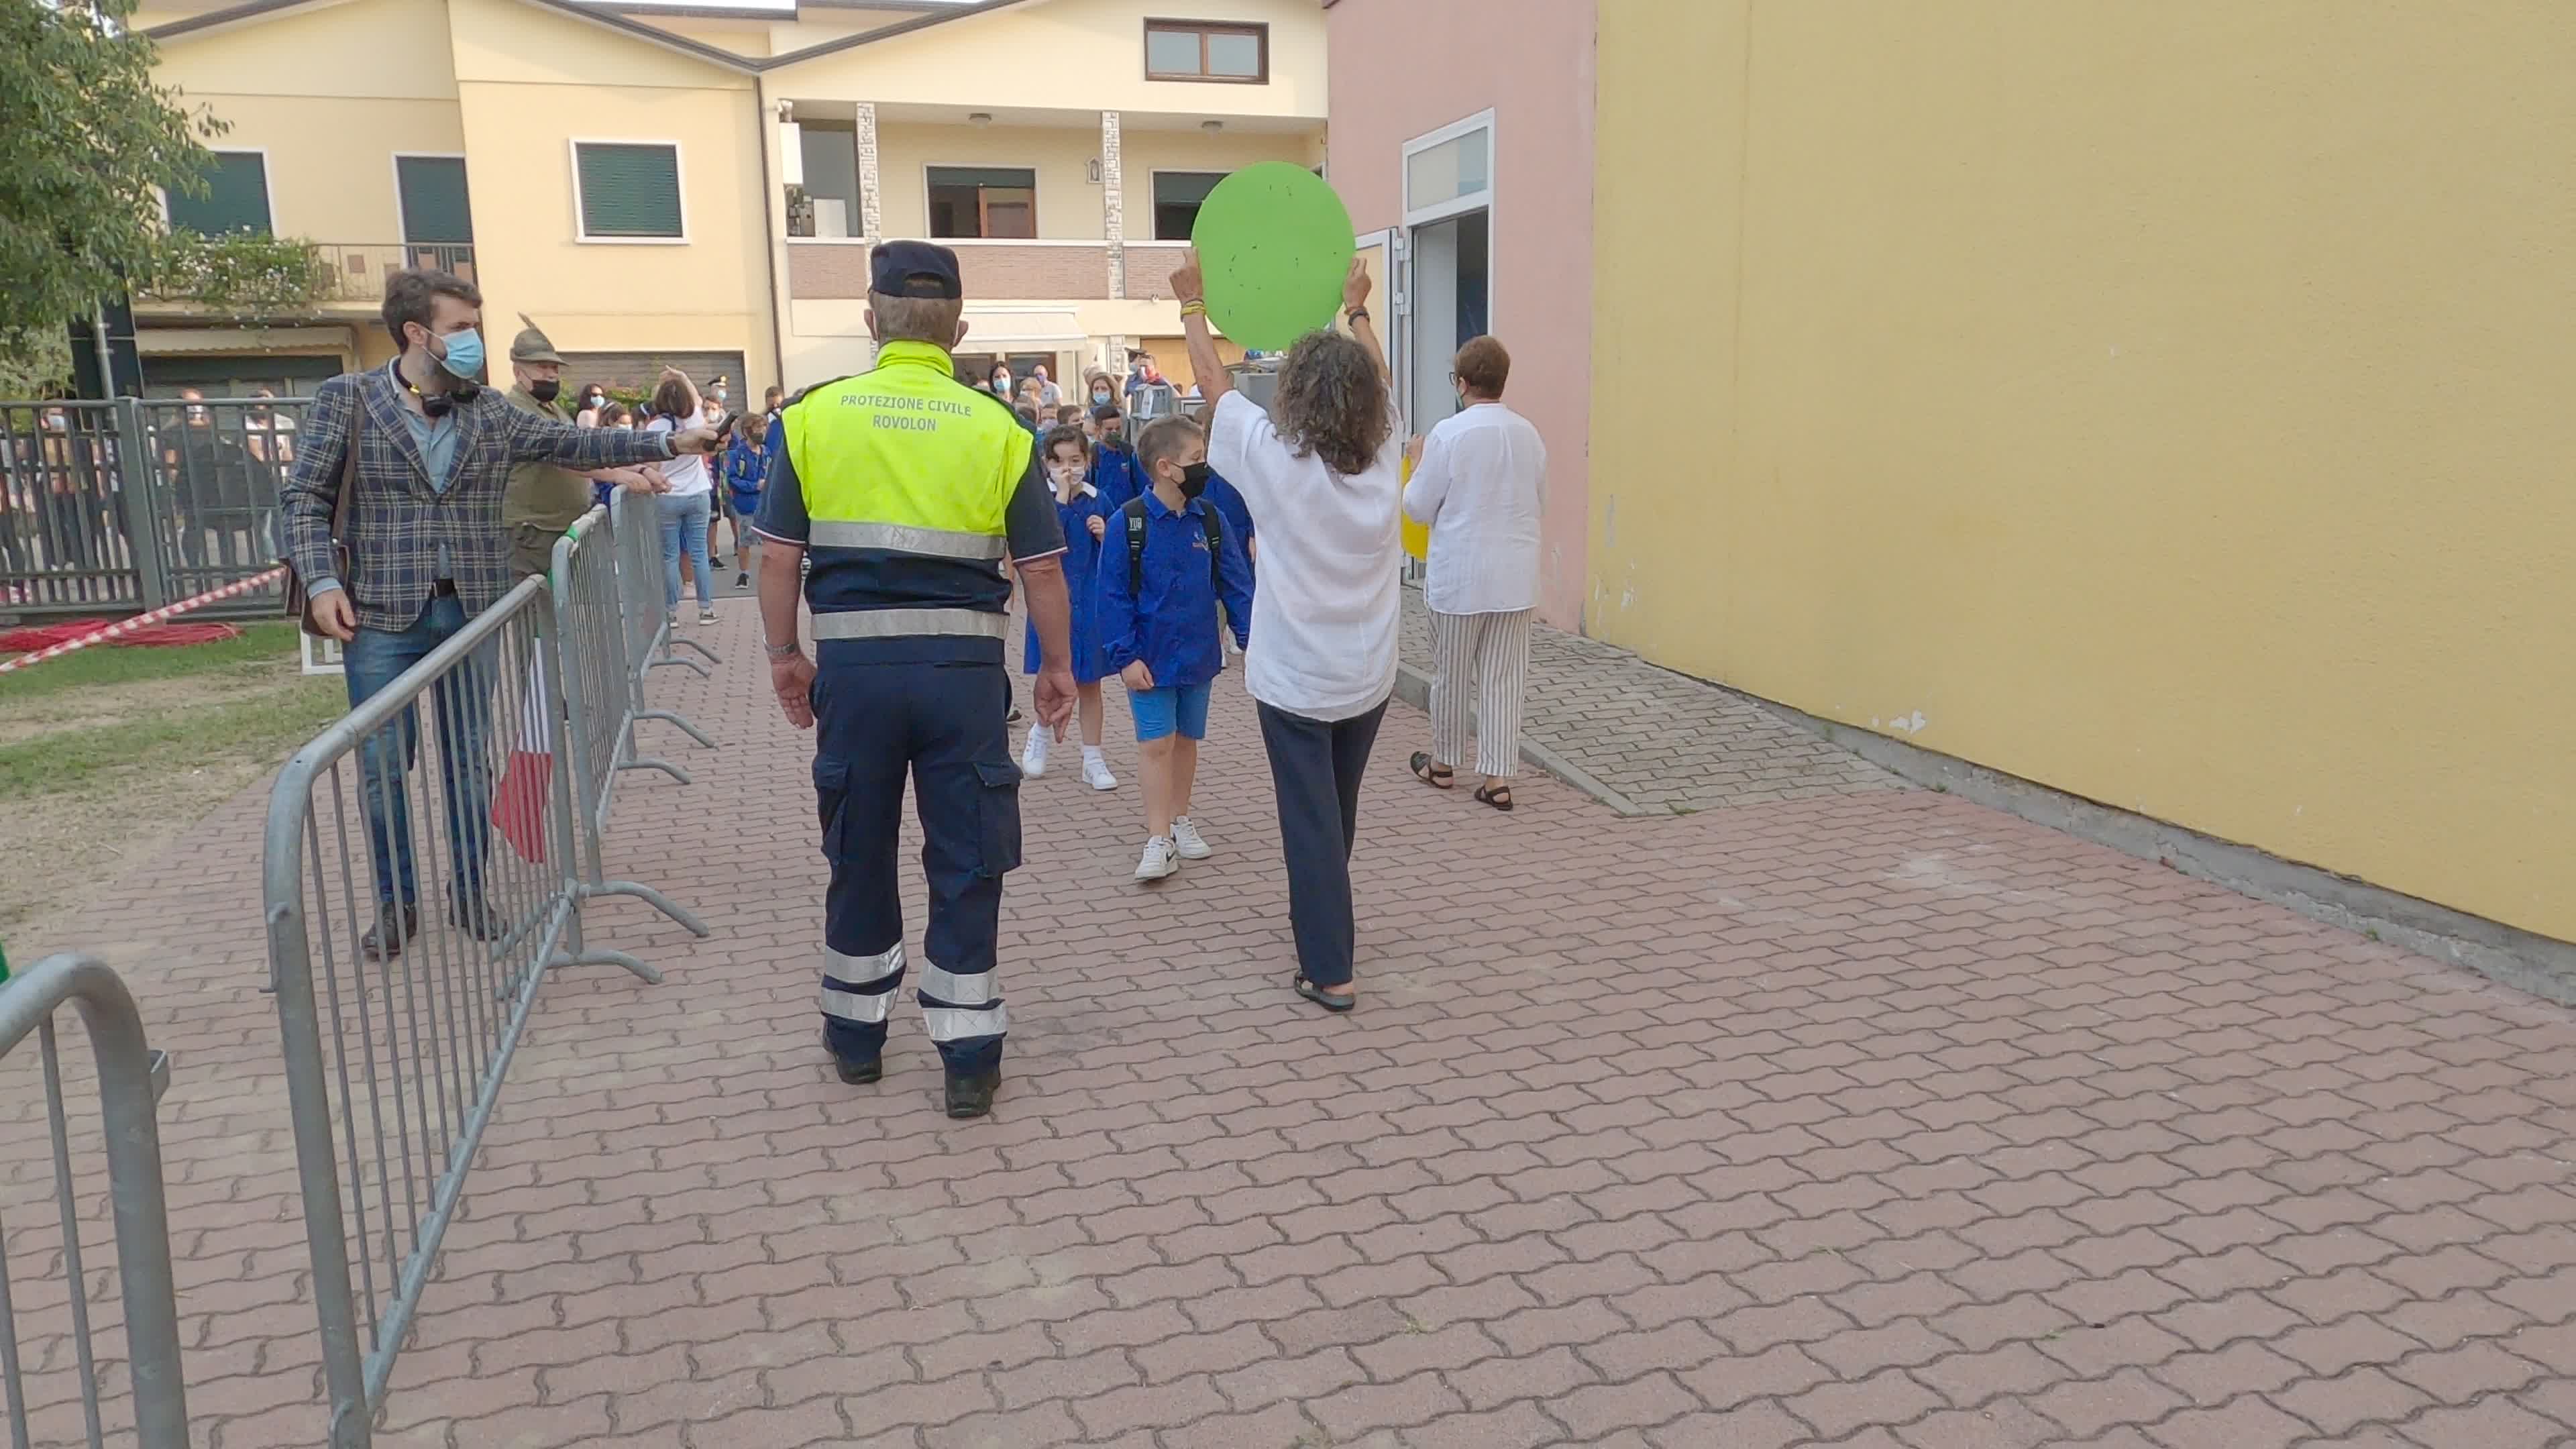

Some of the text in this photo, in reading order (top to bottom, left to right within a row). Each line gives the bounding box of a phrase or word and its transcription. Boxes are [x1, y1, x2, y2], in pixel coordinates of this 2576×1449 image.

[841, 395, 971, 416] PROTEZIONE CIVILE
[873, 415, 936, 431] ROVOLON
